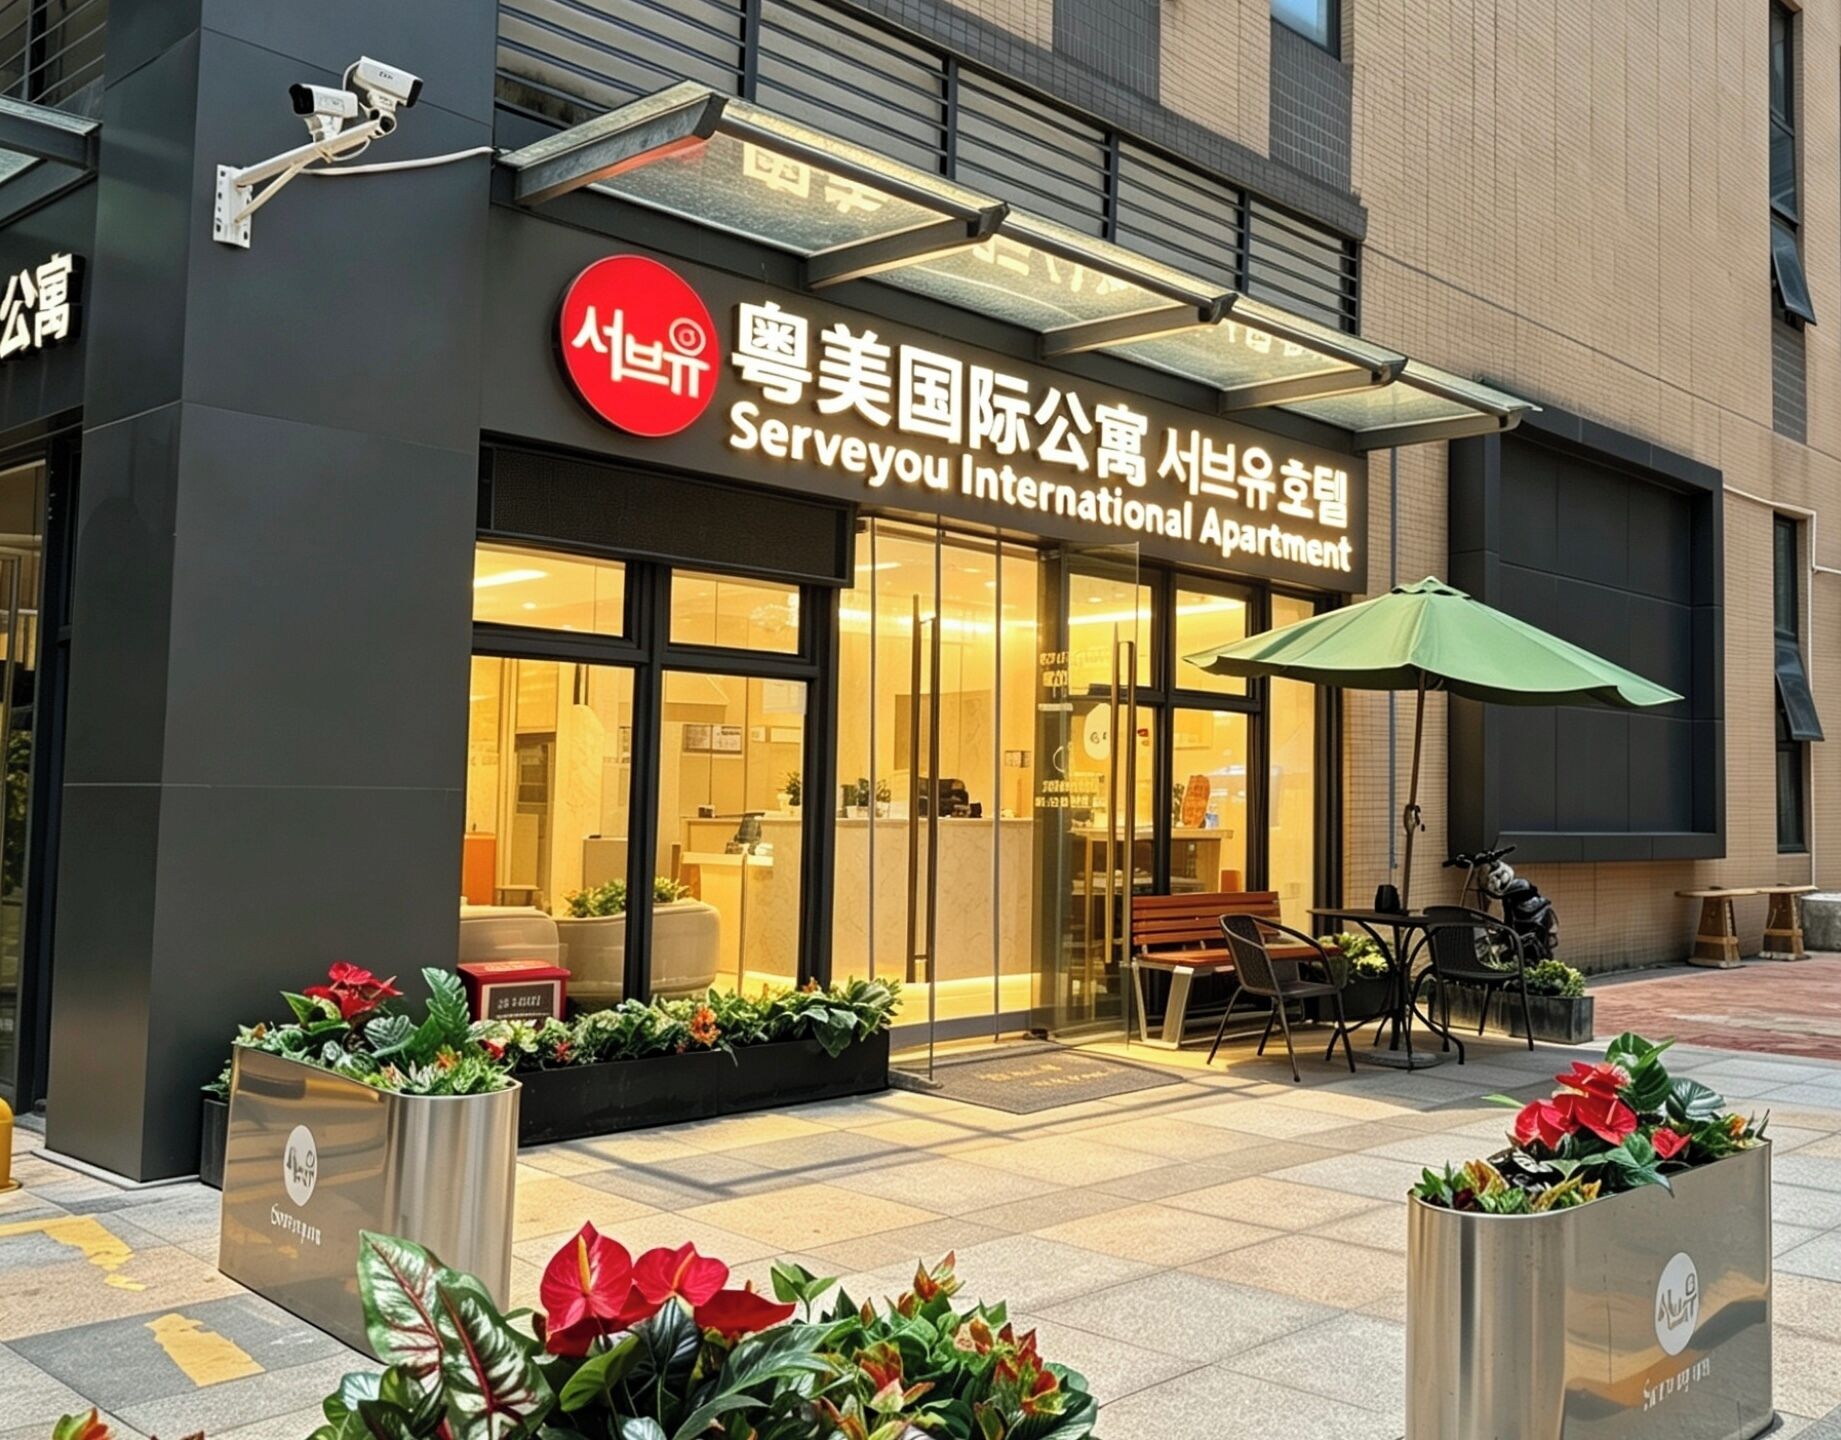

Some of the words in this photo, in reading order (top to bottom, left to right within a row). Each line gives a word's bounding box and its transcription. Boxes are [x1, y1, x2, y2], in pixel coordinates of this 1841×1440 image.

[0, 252, 73, 359] 公寓
[571, 305, 711, 399] 서브유
[731, 301, 1148, 487] 粤美国际公寓
[730, 400, 950, 490] Serveyou
[962, 453, 1193, 541] International
[1199, 506, 1353, 573] Apartment
